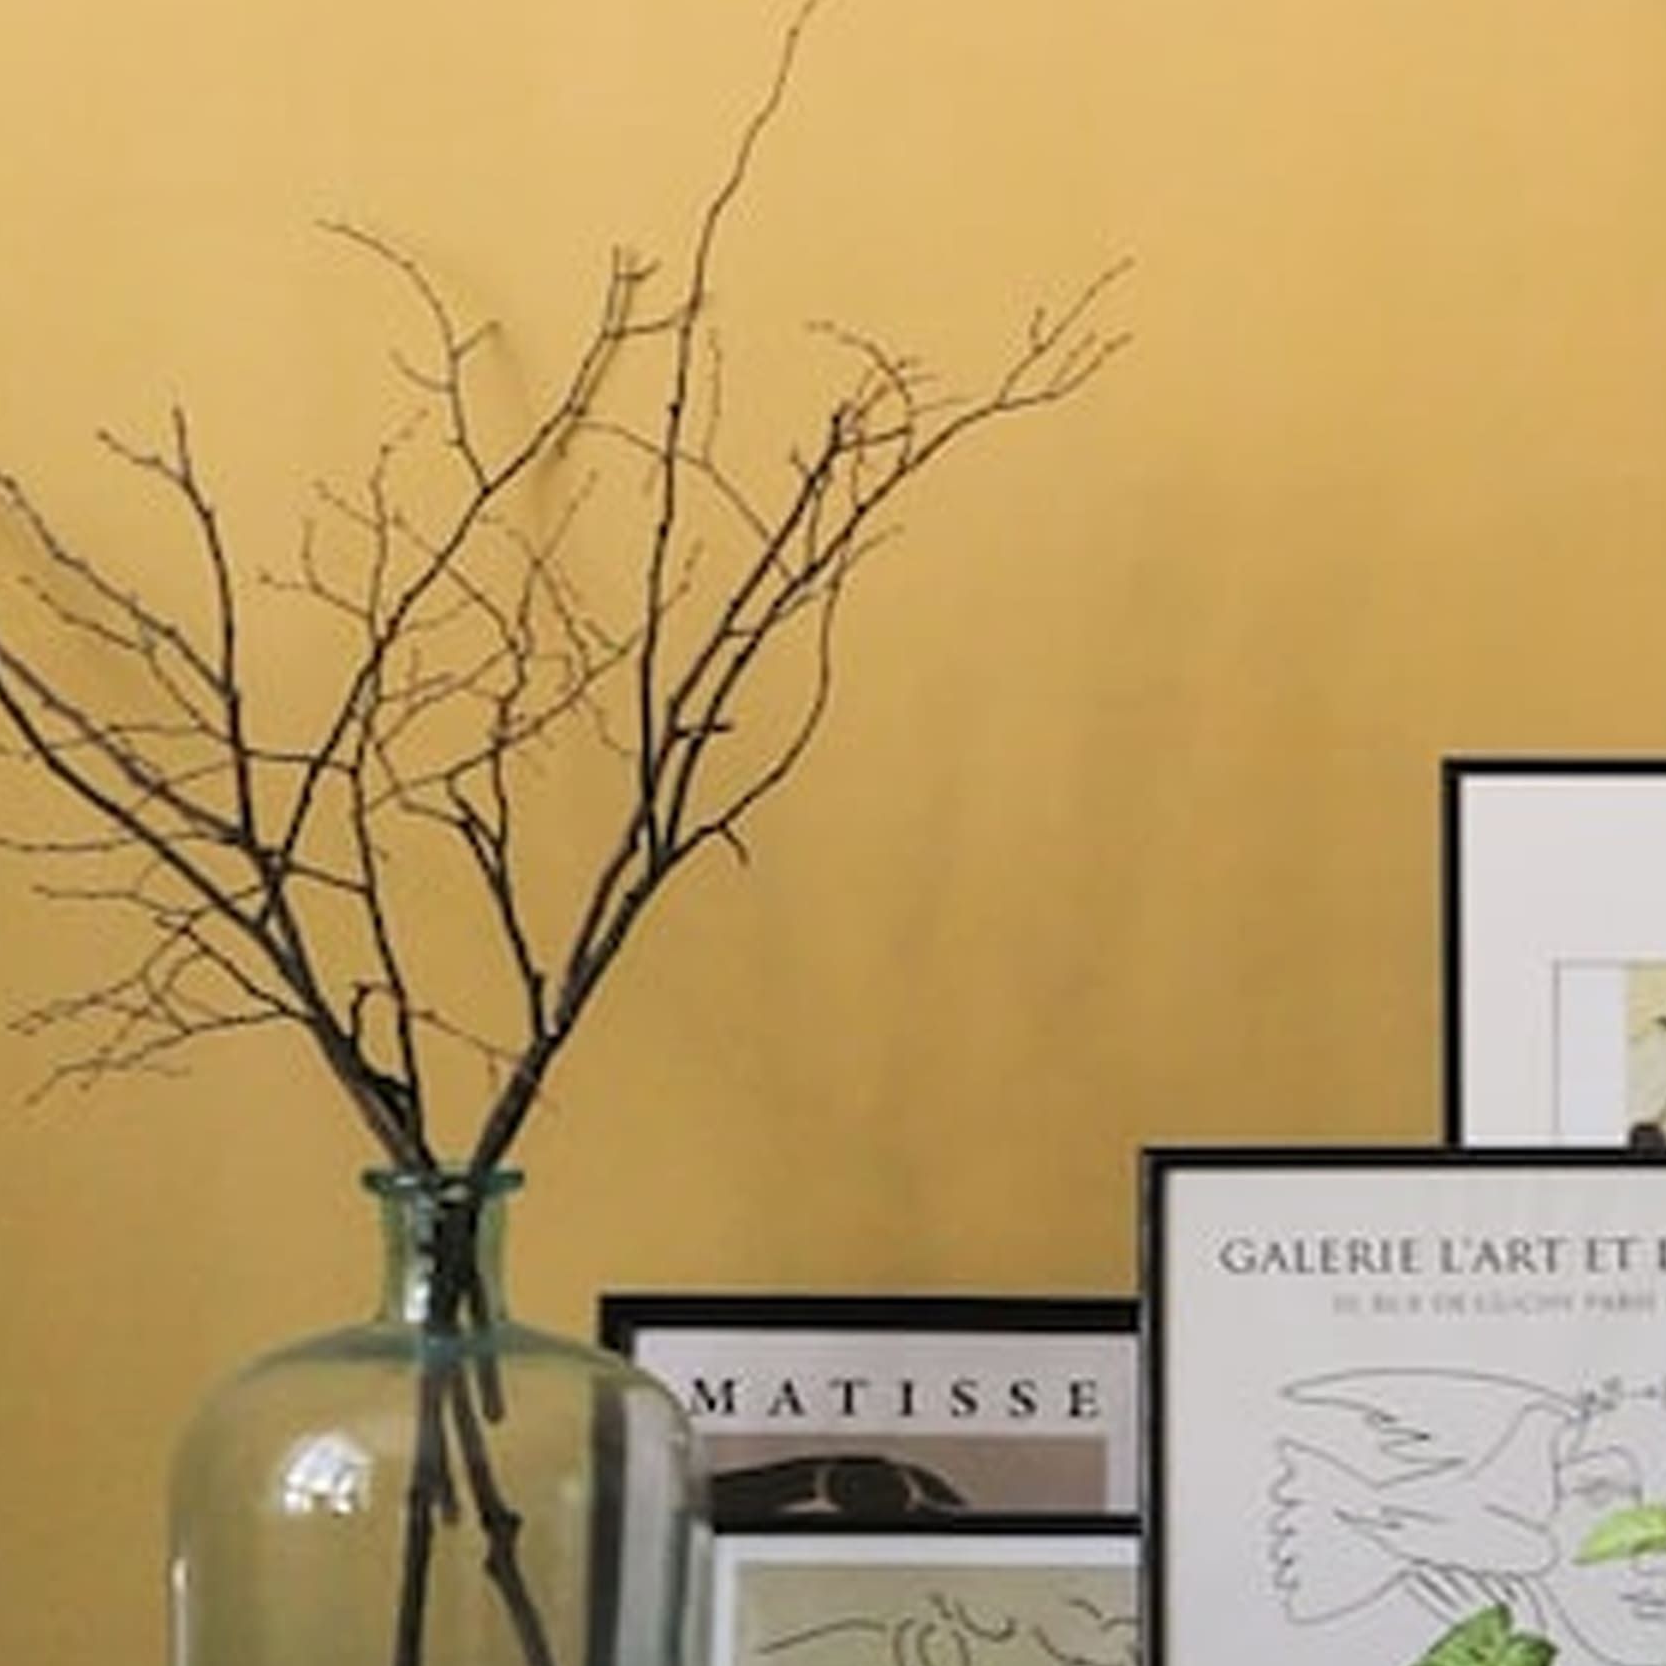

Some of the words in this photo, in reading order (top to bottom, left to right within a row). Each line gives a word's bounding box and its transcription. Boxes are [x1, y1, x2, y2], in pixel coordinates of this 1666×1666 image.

[1217, 1236, 1422, 1275] GALERIE
[1439, 1235, 1570, 1274] L'ART
[1586, 1236, 1641, 1274] ET
[689, 1378, 1101, 1418] MATISSE
